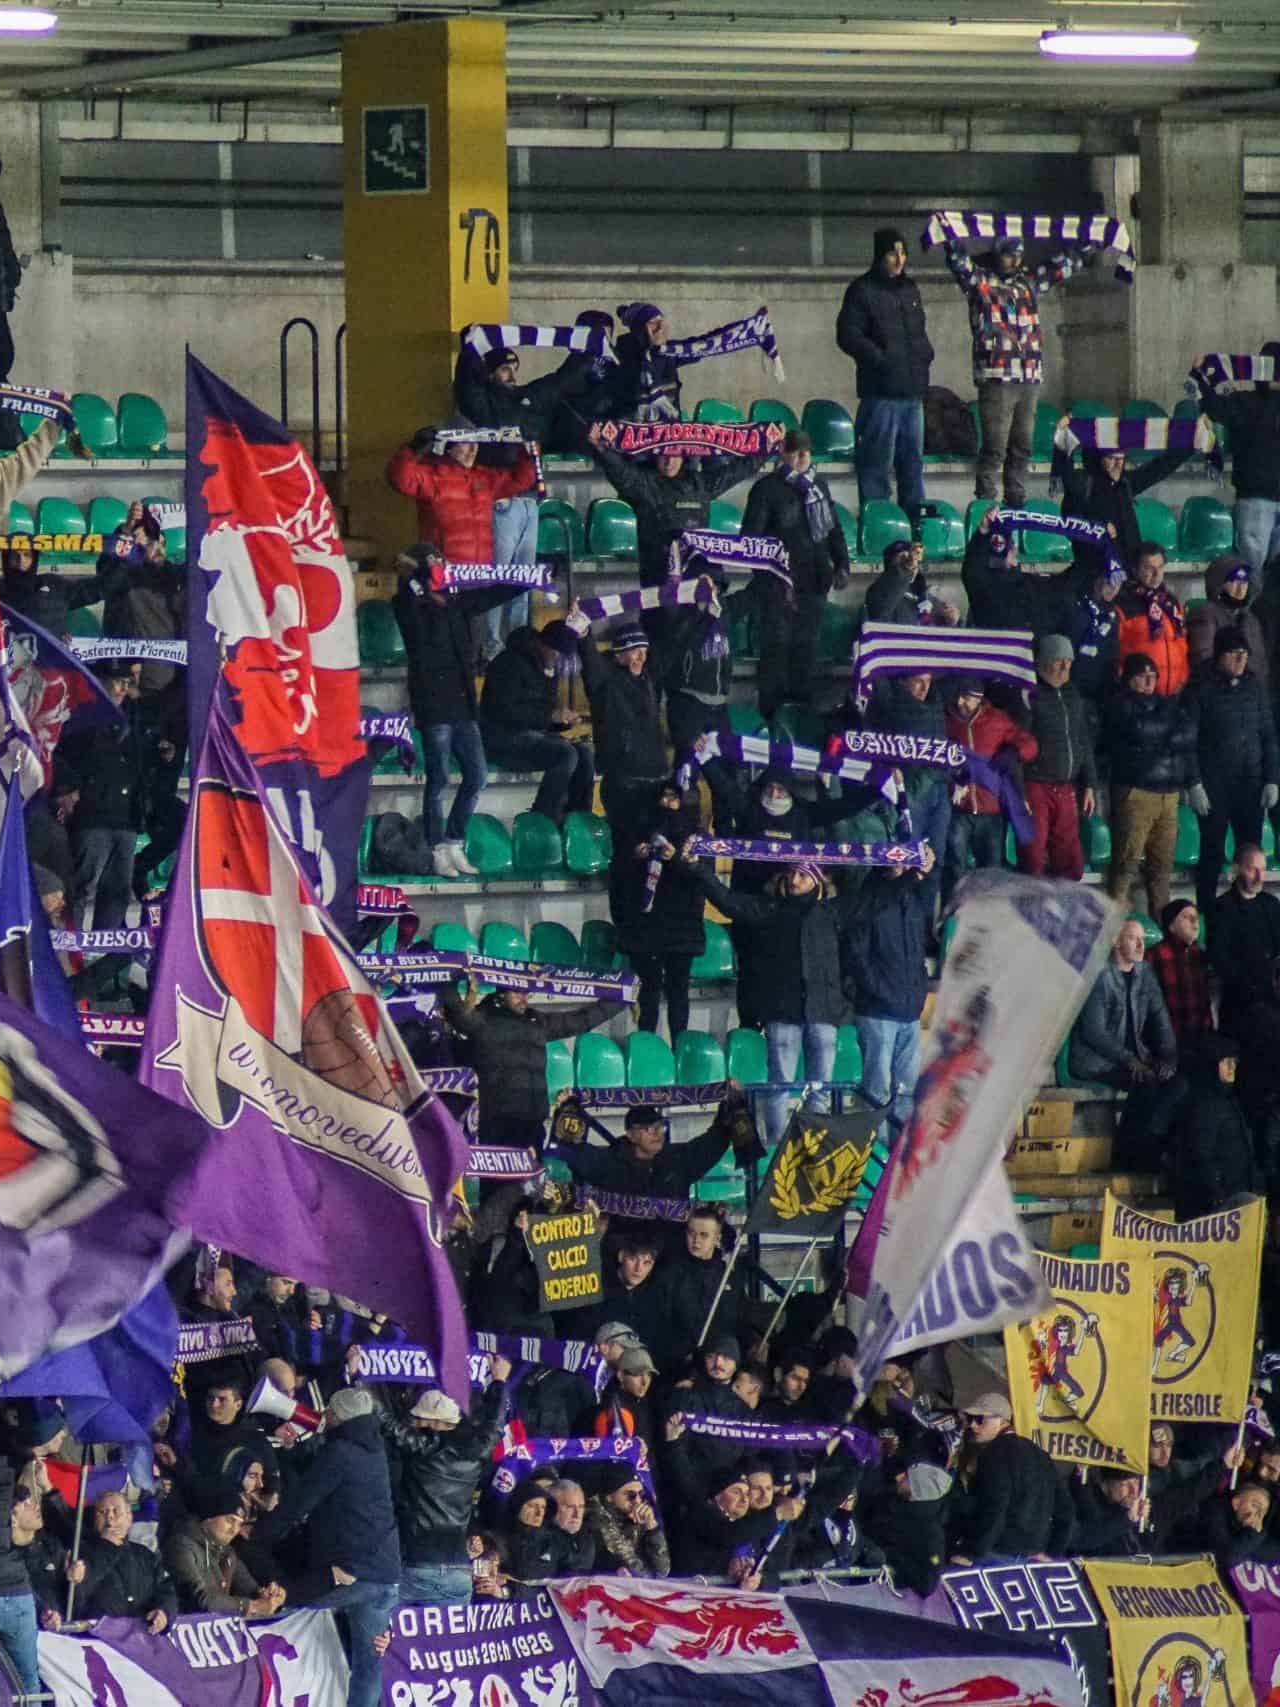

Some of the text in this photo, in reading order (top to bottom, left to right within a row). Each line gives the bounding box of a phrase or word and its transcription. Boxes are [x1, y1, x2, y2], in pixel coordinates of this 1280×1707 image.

[459, 207, 501, 285] 70
[652, 423, 761, 451] FIORENTINA
[997, 508, 1106, 541] FIORENTINA
[469, 1149, 532, 1172] ORENTINA
[531, 1214, 597, 1246] CONTRO IL
[548, 1243, 588, 1270] CALCIO
[544, 1271, 599, 1302] MODERNO
[1160, 1392, 1223, 1418] FIESOLE
[1107, 1580, 1231, 1619] AFICIONADOS
[397, 1603, 516, 1638] ORENTINA
[409, 1646, 481, 1673] August
[513, 1631, 555, 1659] 1926
